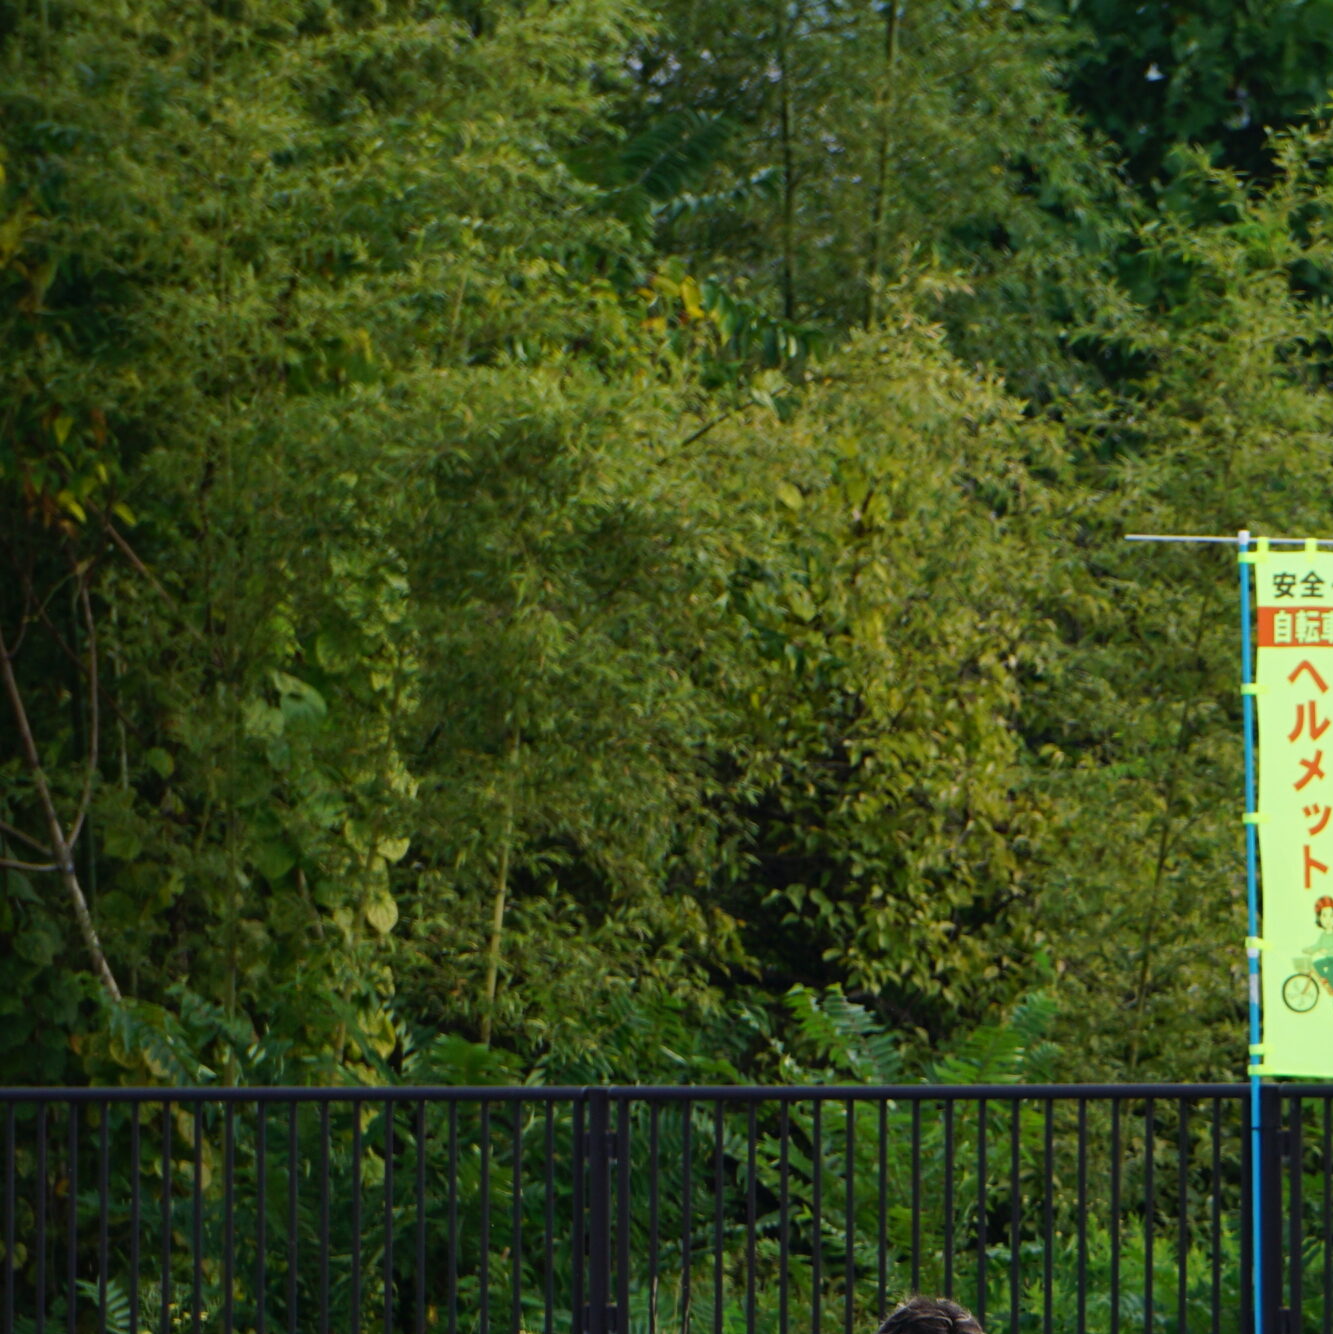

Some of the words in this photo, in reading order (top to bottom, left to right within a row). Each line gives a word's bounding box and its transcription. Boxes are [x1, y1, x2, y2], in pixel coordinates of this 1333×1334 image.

[1287, 659, 1332, 889] ヘルメット
